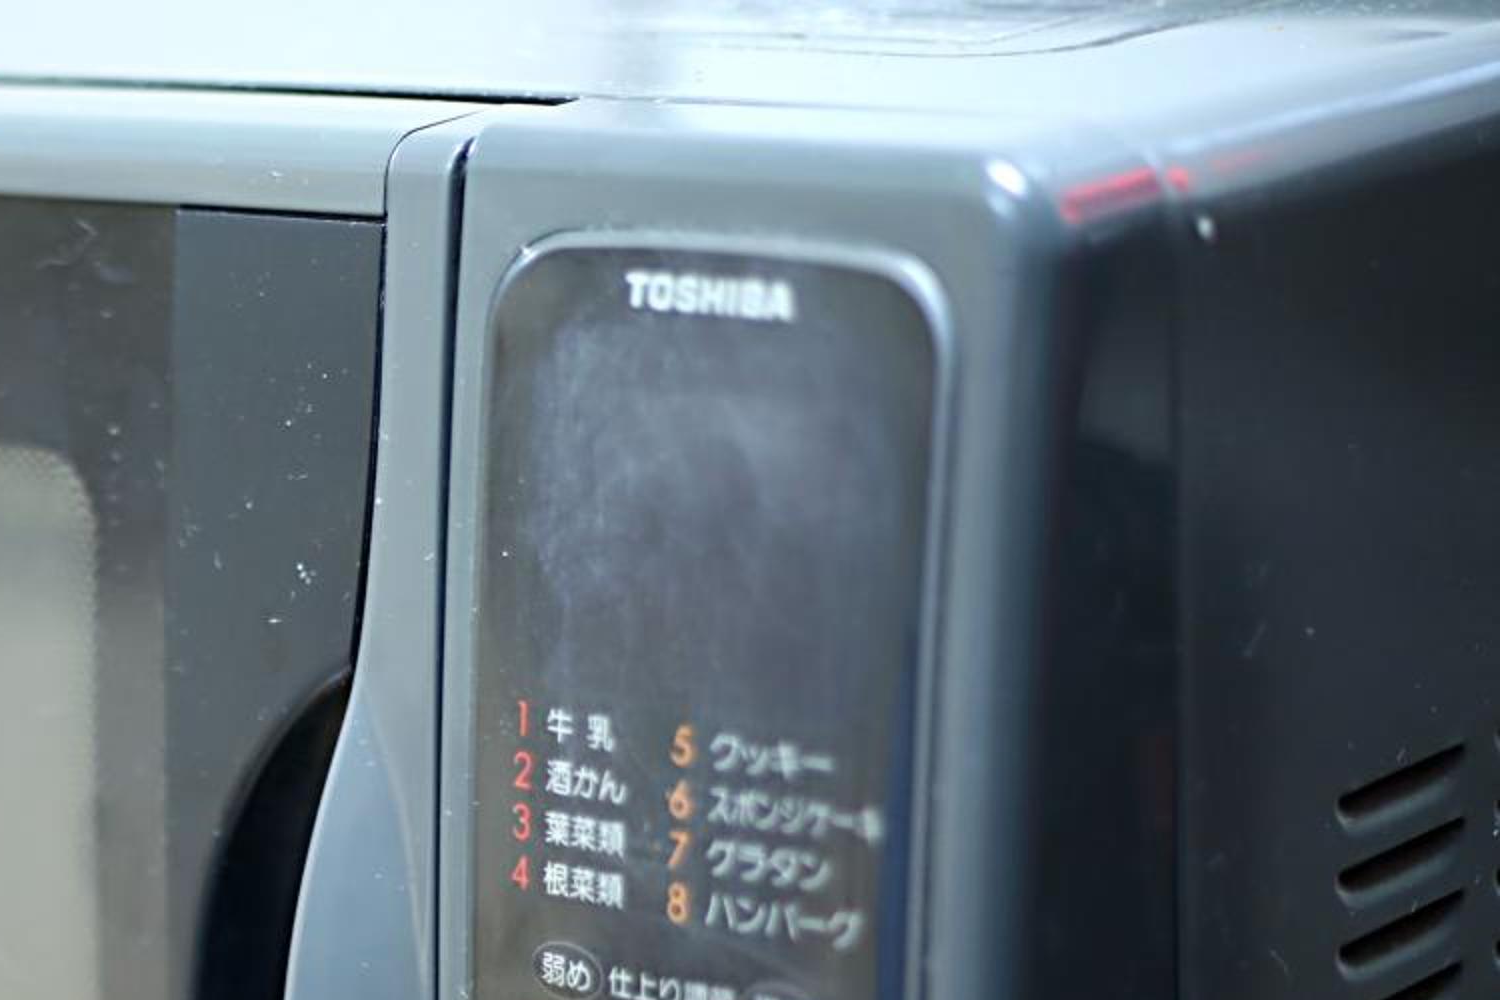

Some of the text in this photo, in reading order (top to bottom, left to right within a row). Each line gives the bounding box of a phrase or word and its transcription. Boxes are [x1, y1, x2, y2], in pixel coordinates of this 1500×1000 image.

[625, 270, 795, 322] TOSHIBA
[518, 701, 529, 736] 1
[513, 751, 628, 805] 2 酒かん
[669, 725, 834, 779] 5 クッキー
[666, 778, 694, 820] 6
[512, 803, 626, 864] 3 葉菜類
[511, 855, 625, 910] 4 根菜類
[667, 830, 833, 892] 7 グラタン
[666, 881, 865, 952] 8 ハンバーグ
[539, 950, 592, 993] 弱め
